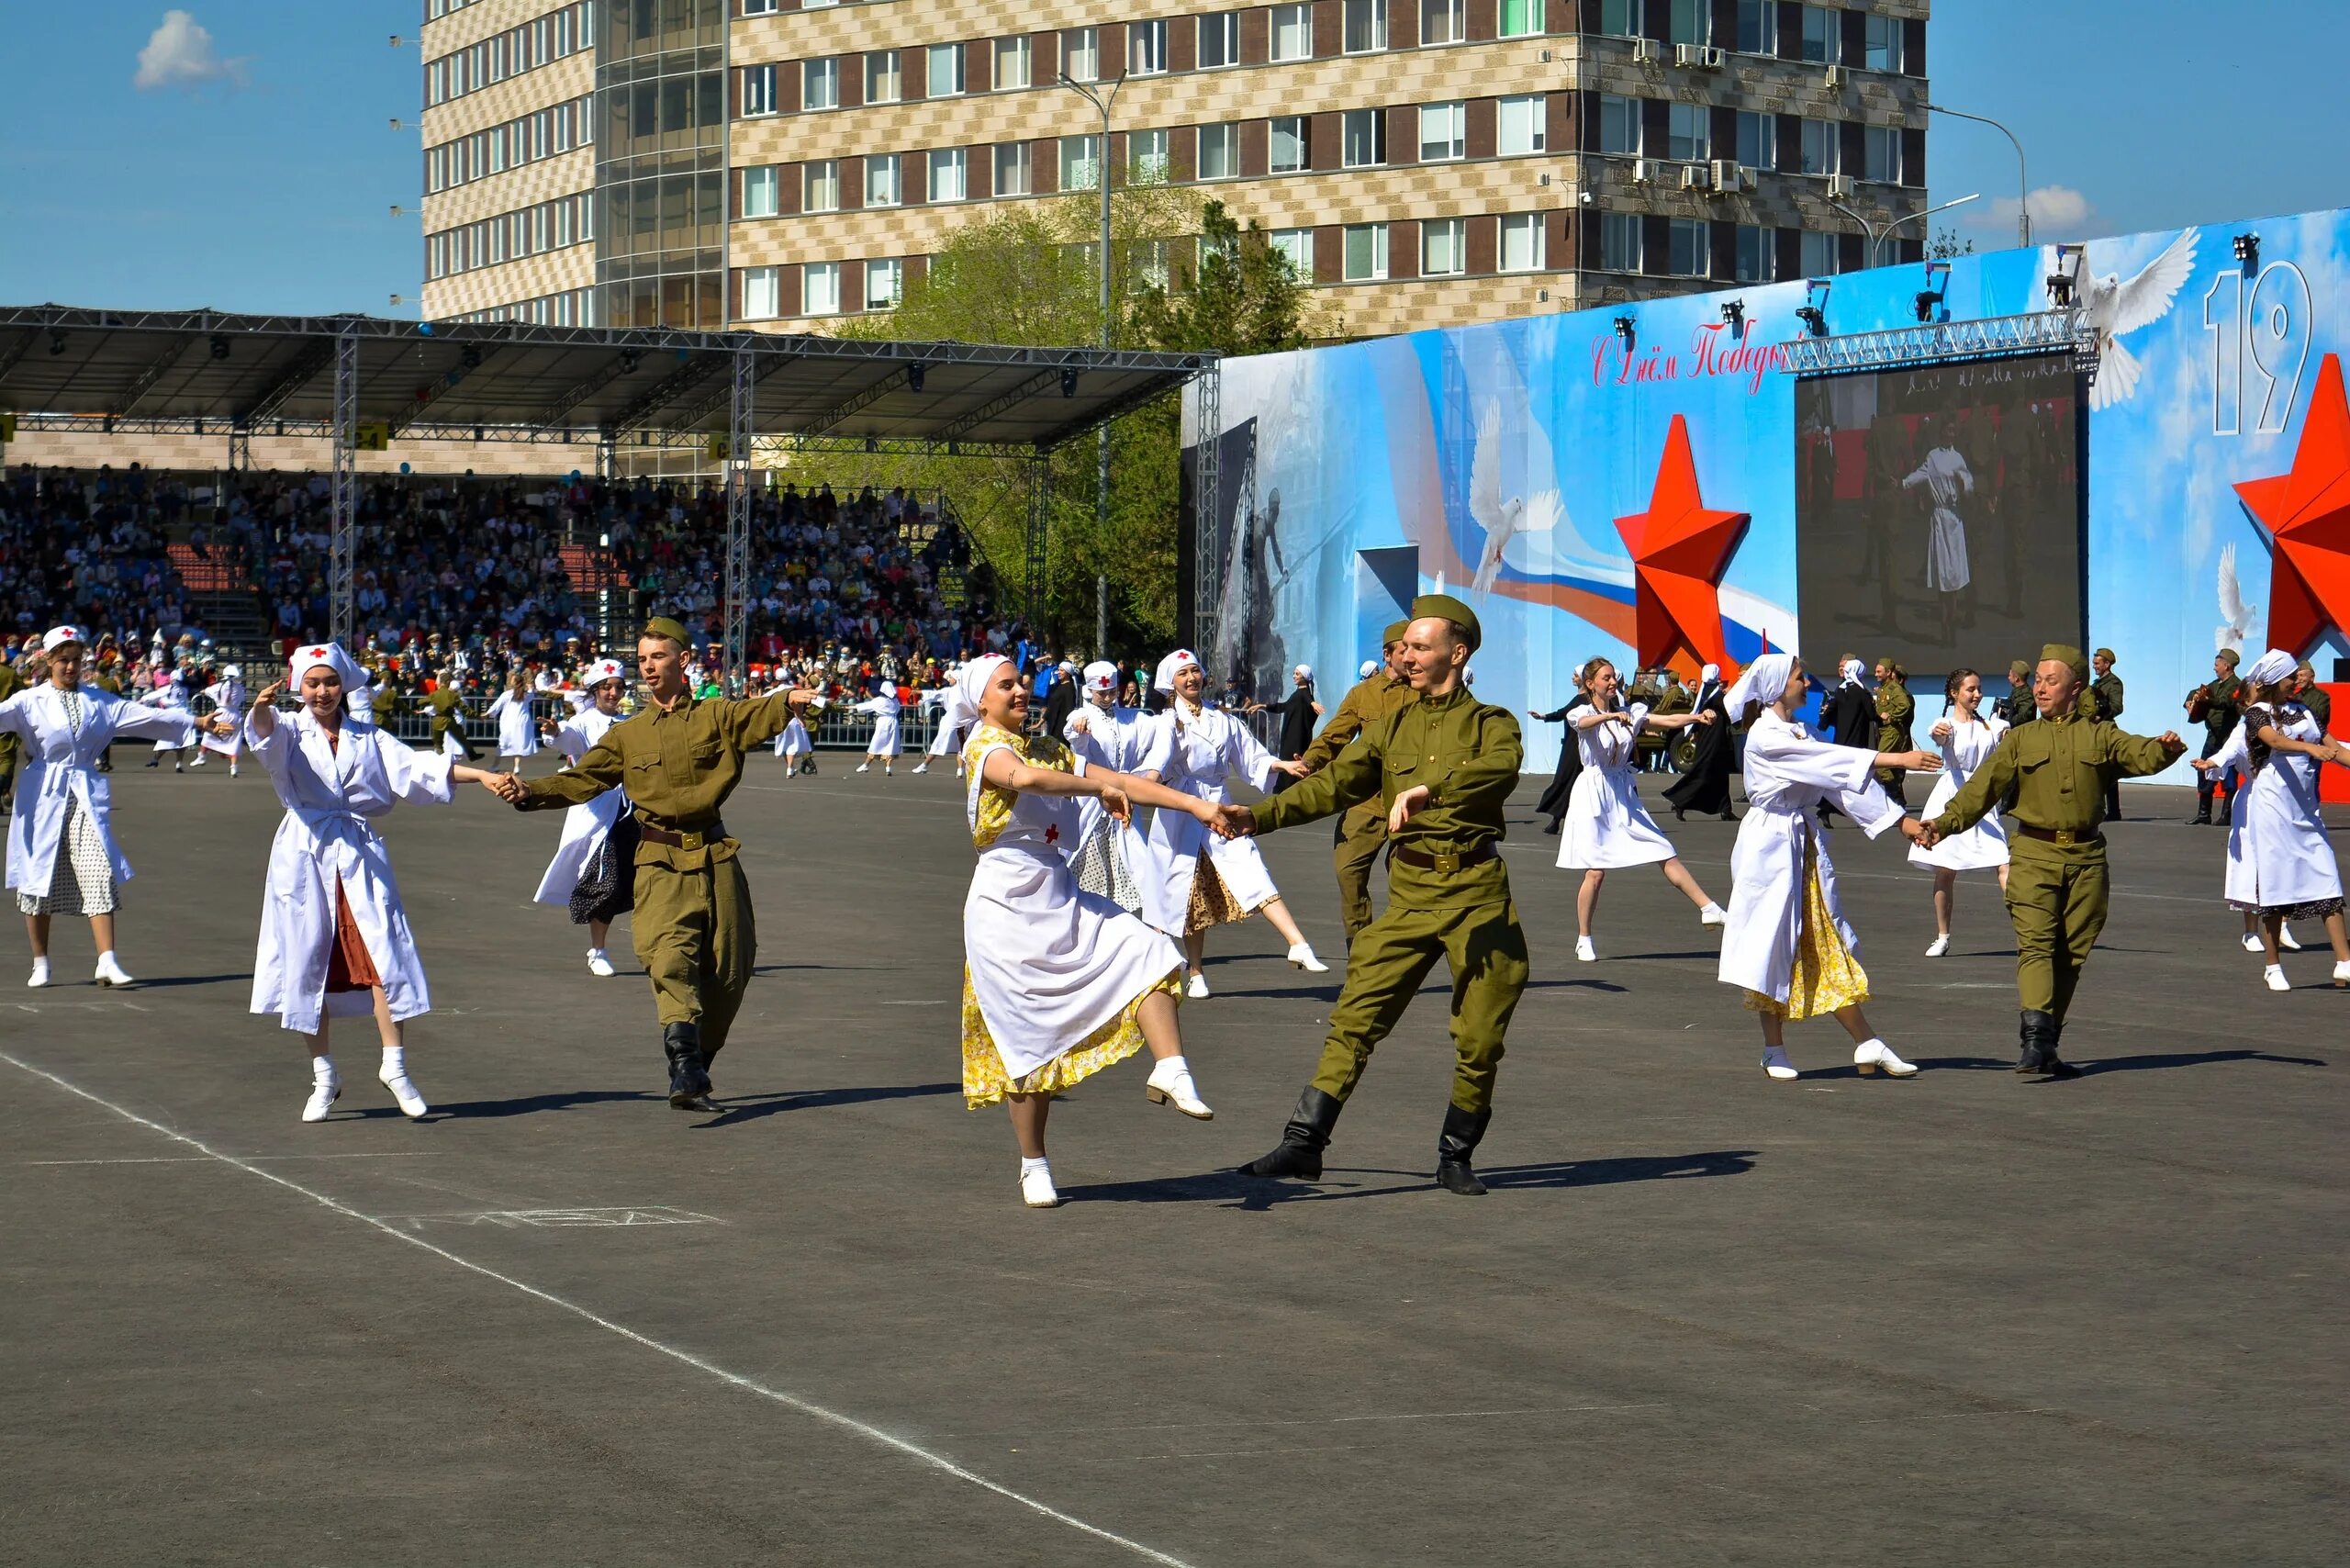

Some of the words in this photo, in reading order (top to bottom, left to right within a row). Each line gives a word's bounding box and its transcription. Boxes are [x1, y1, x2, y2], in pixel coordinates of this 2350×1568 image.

[1591, 334, 1614, 387] С
[1616, 335, 1678, 384] Днём
[1686, 319, 1803, 396] Победы
[2204, 260, 2312, 435] 19
